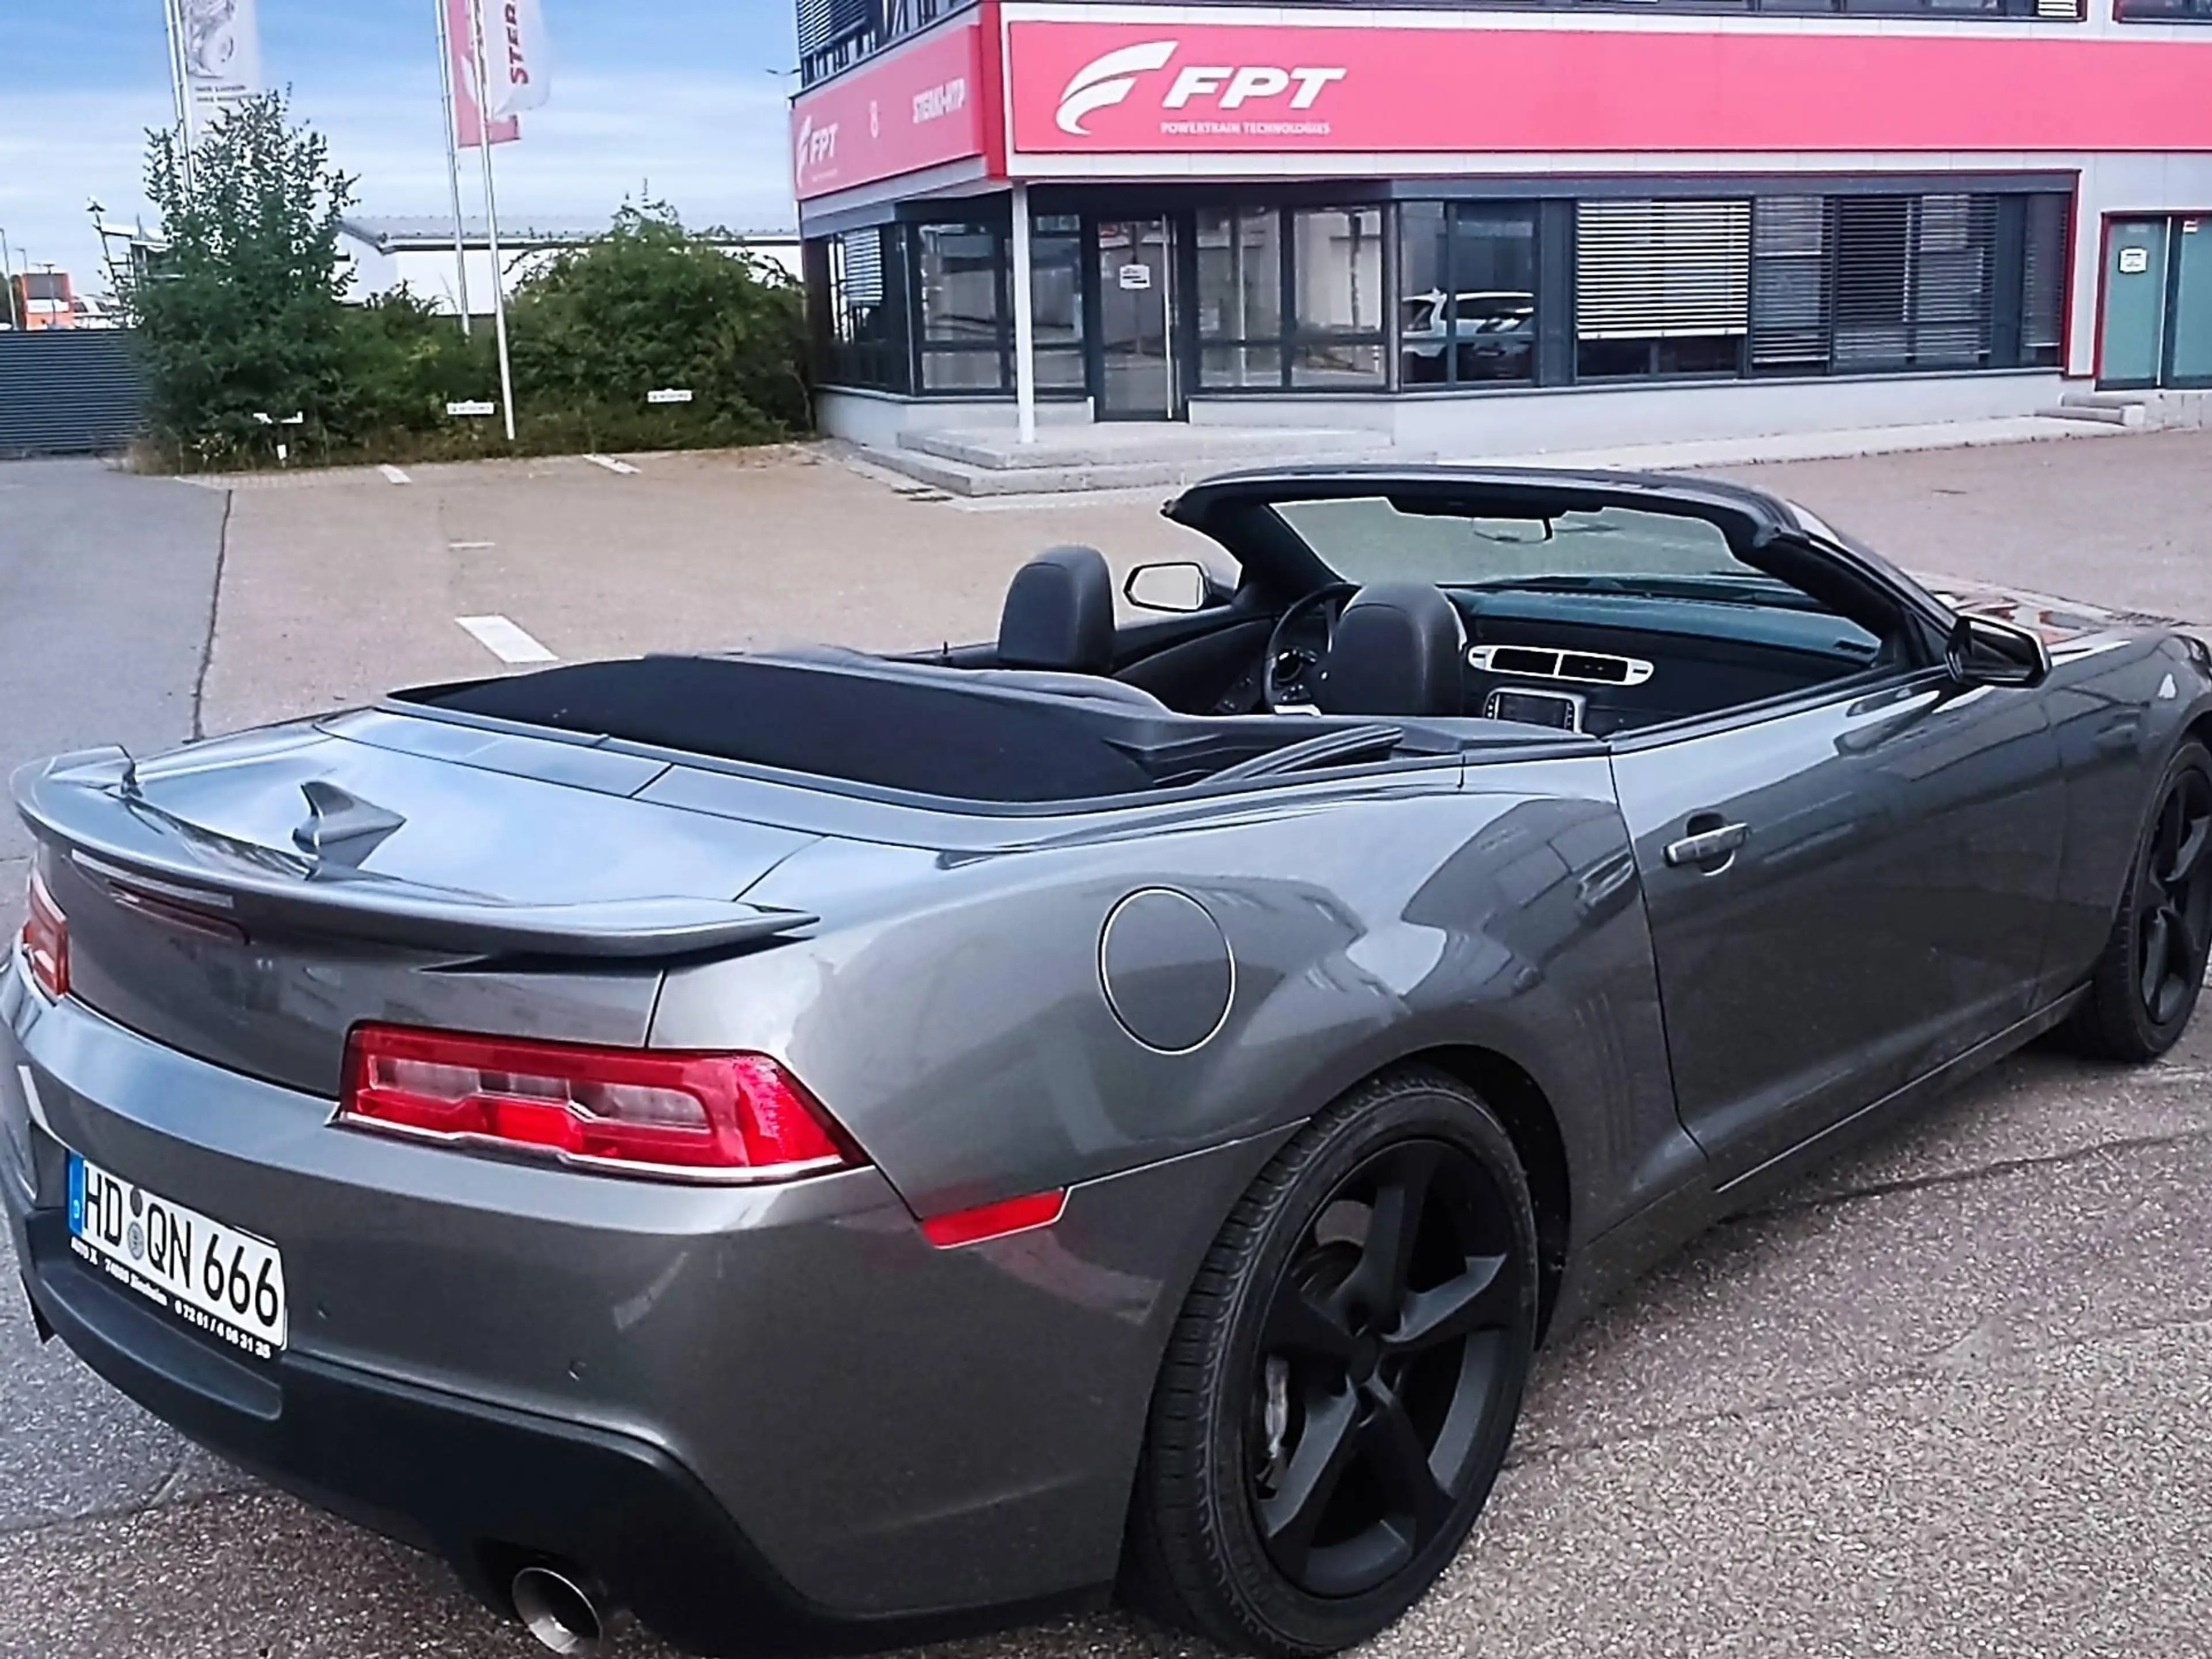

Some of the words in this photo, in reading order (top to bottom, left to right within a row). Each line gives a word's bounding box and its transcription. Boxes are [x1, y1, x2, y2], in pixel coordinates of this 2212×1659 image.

[505, 0, 529, 84] STER
[1162, 67, 1347, 108] FPT
[810, 122, 839, 165] FPT
[1160, 122, 1240, 134] POWERTRAIN
[1242, 122, 1331, 134] TECHNOLOGIES
[85, 1166, 123, 1248] HD
[148, 1203, 191, 1289] QN
[203, 1233, 278, 1328] 666
